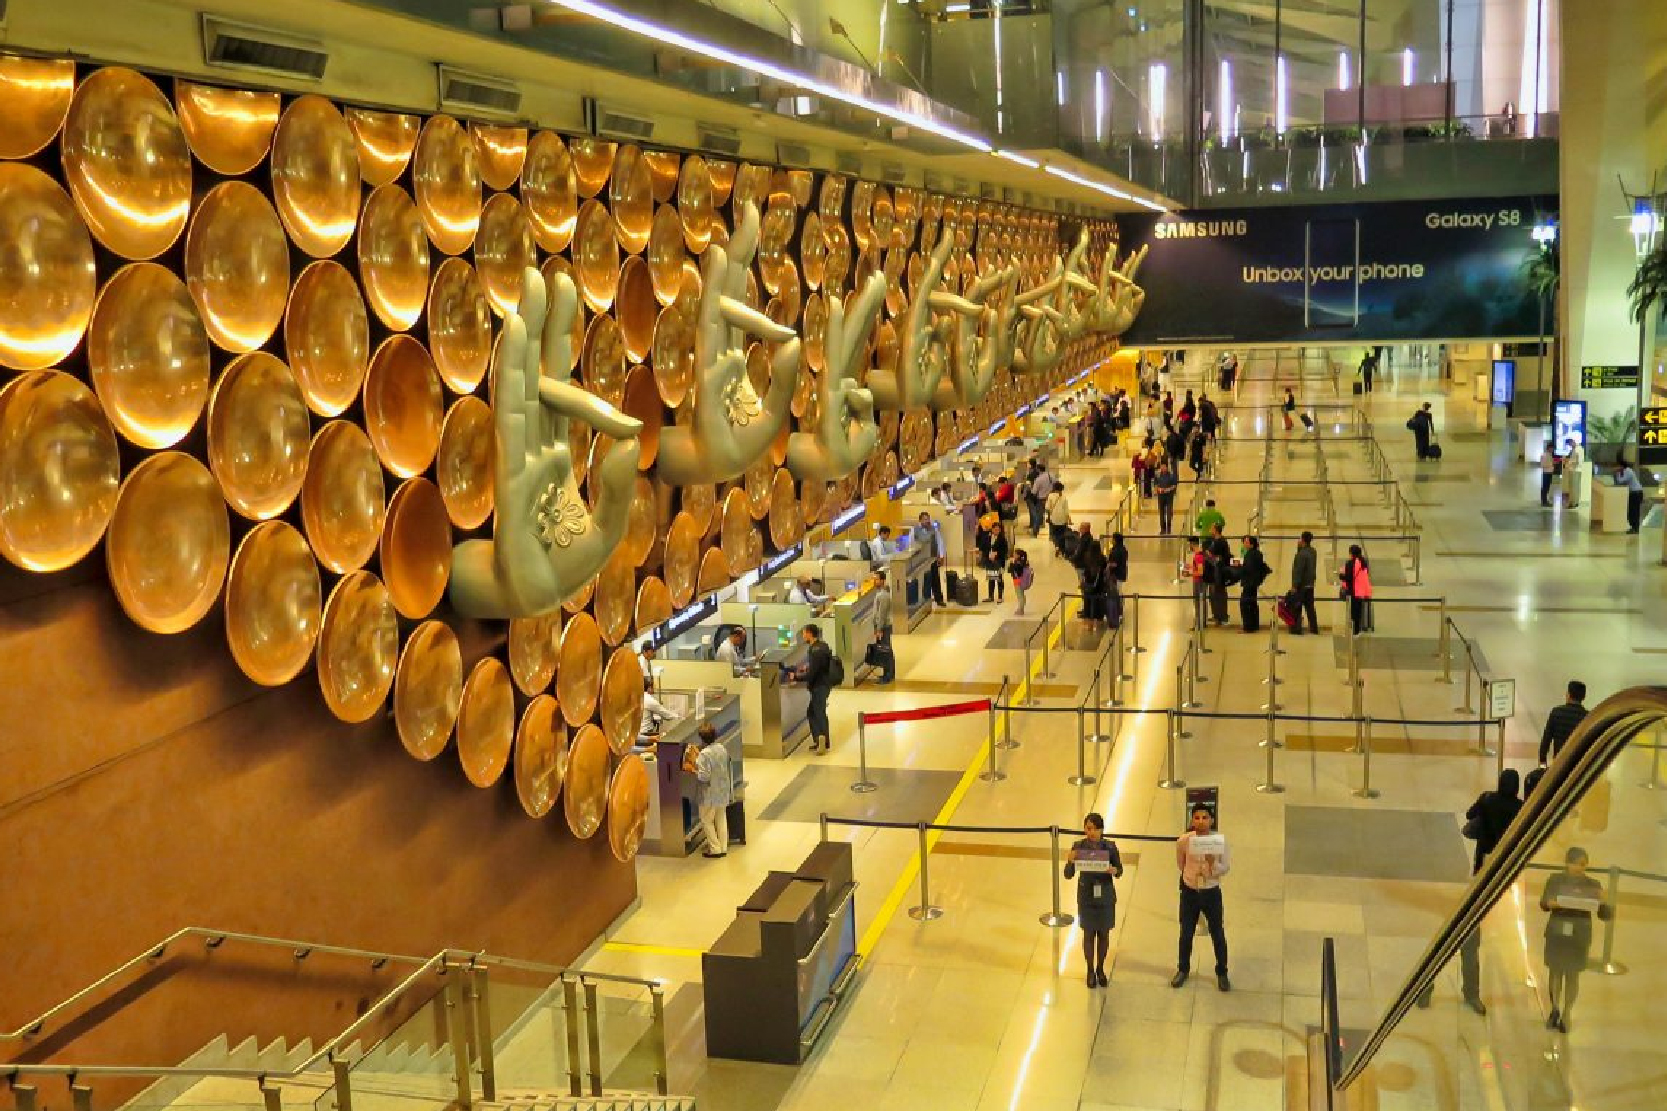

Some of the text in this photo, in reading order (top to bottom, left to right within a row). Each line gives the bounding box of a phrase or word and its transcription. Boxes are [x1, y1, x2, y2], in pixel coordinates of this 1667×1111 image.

[1154, 220, 1247, 239] SAMSUNG
[1425, 209, 1520, 231] Galaxy S8
[1243, 261, 1425, 286] Unbox your phone
